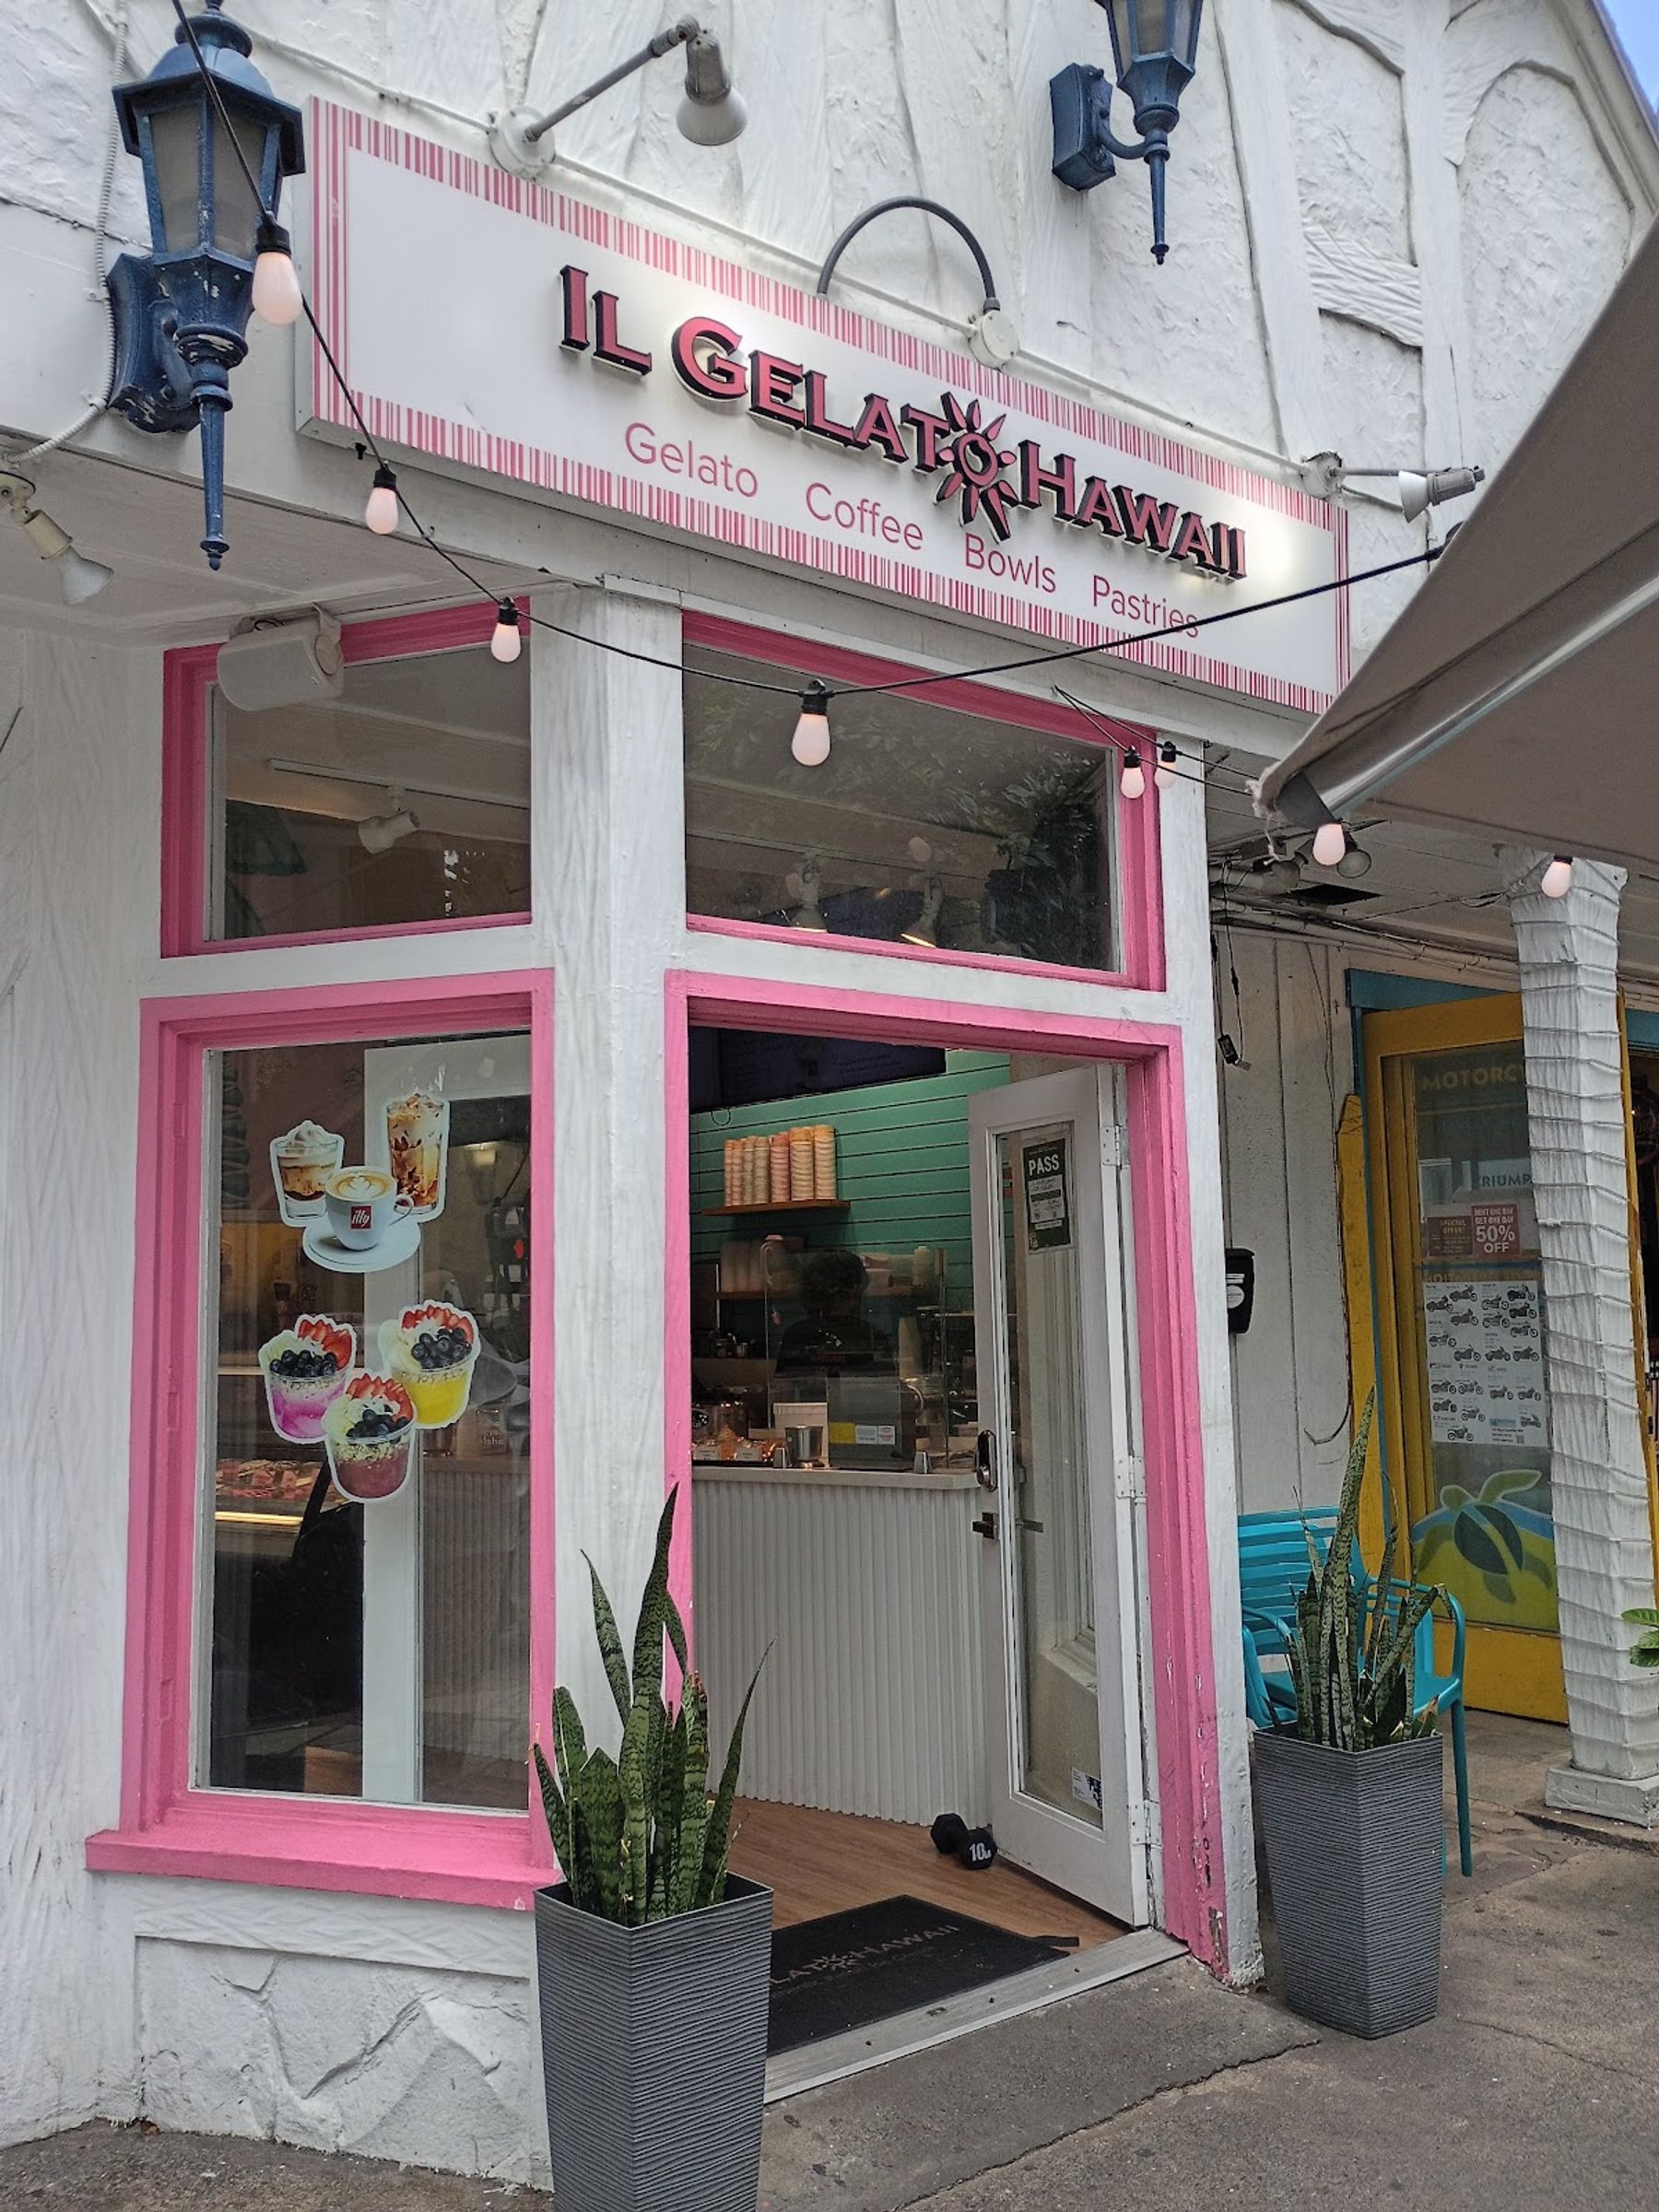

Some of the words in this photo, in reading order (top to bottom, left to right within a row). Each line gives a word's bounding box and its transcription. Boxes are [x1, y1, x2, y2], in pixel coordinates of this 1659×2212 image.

[559, 265, 653, 377] IL
[671, 316, 1005, 493] GELATO
[1018, 440, 1247, 582] HAWAII
[625, 422, 759, 498] Gelato
[805, 482, 924, 551] Coffee
[964, 533, 1057, 594] Bowls
[1092, 574, 1199, 639] Pastries
[1028, 1154, 1060, 1176] PASS
[1481, 1173, 1534, 1187] RIUMP
[352, 1209, 371, 1228] illy
[1476, 1225, 1515, 1242] 50%
[1483, 1242, 1510, 1253] OFF
